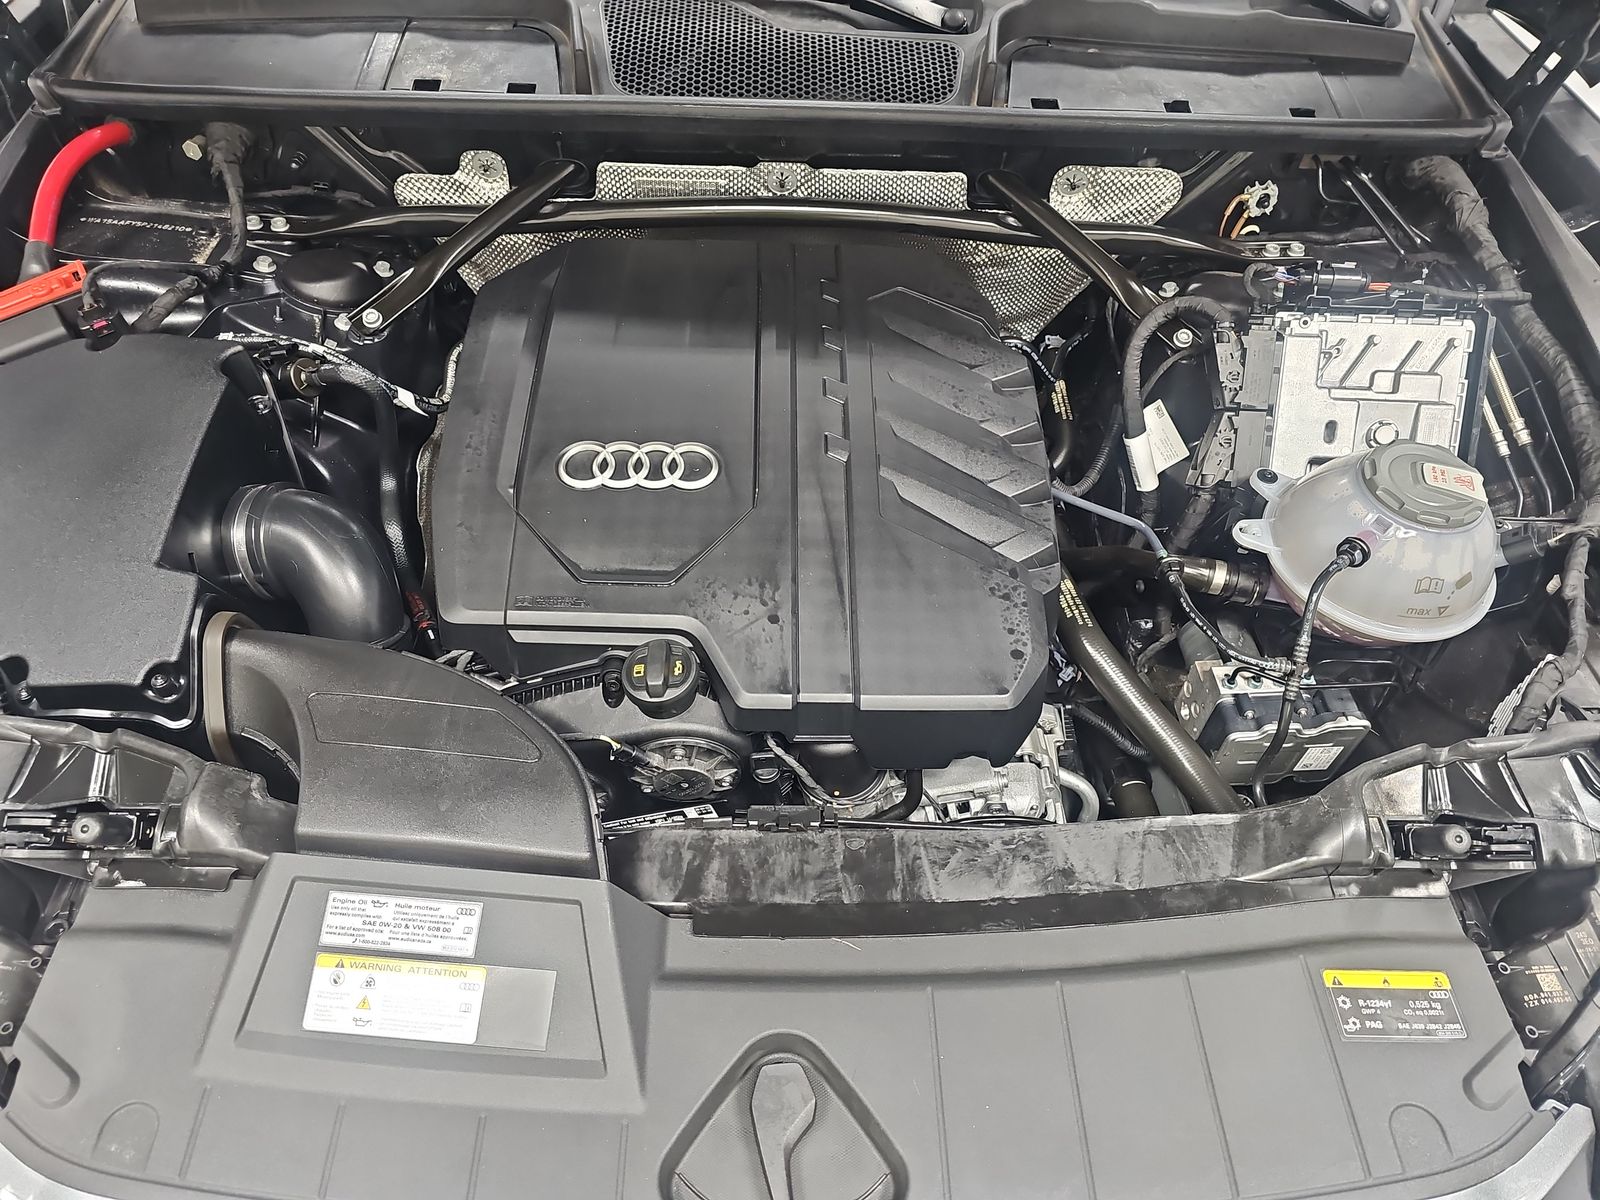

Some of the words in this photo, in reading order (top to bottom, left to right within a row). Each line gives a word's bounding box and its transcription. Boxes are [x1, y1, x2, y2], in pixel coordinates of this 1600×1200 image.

[1406, 608, 1432, 616] max
[350, 961, 402, 972] WARNING
[408, 966, 468, 978] ATTENTION
[1358, 999, 1392, 1009] R-1234yf
[1431, 1001, 1441, 1009] kg
